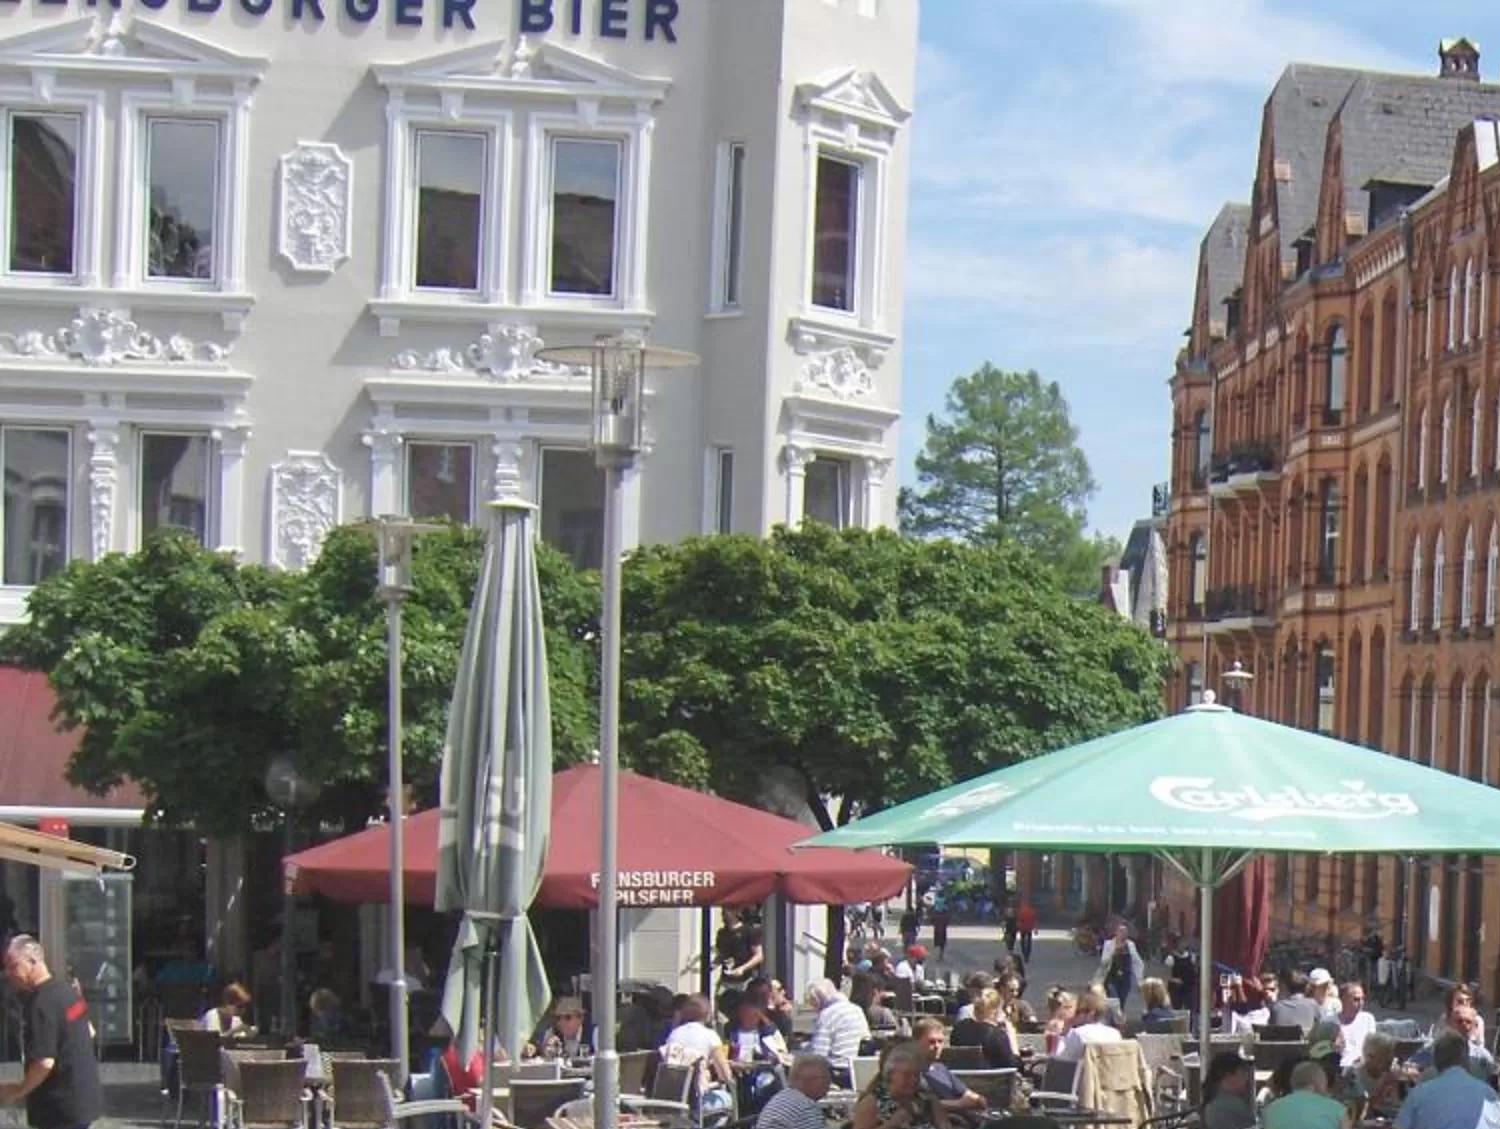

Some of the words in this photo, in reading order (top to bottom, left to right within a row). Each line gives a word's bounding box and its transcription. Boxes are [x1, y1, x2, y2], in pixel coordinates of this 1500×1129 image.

[520, 0, 678, 43] BIER
[1149, 775, 1420, 821] Carlsberg
[591, 870, 716, 889] FNSBURGER
